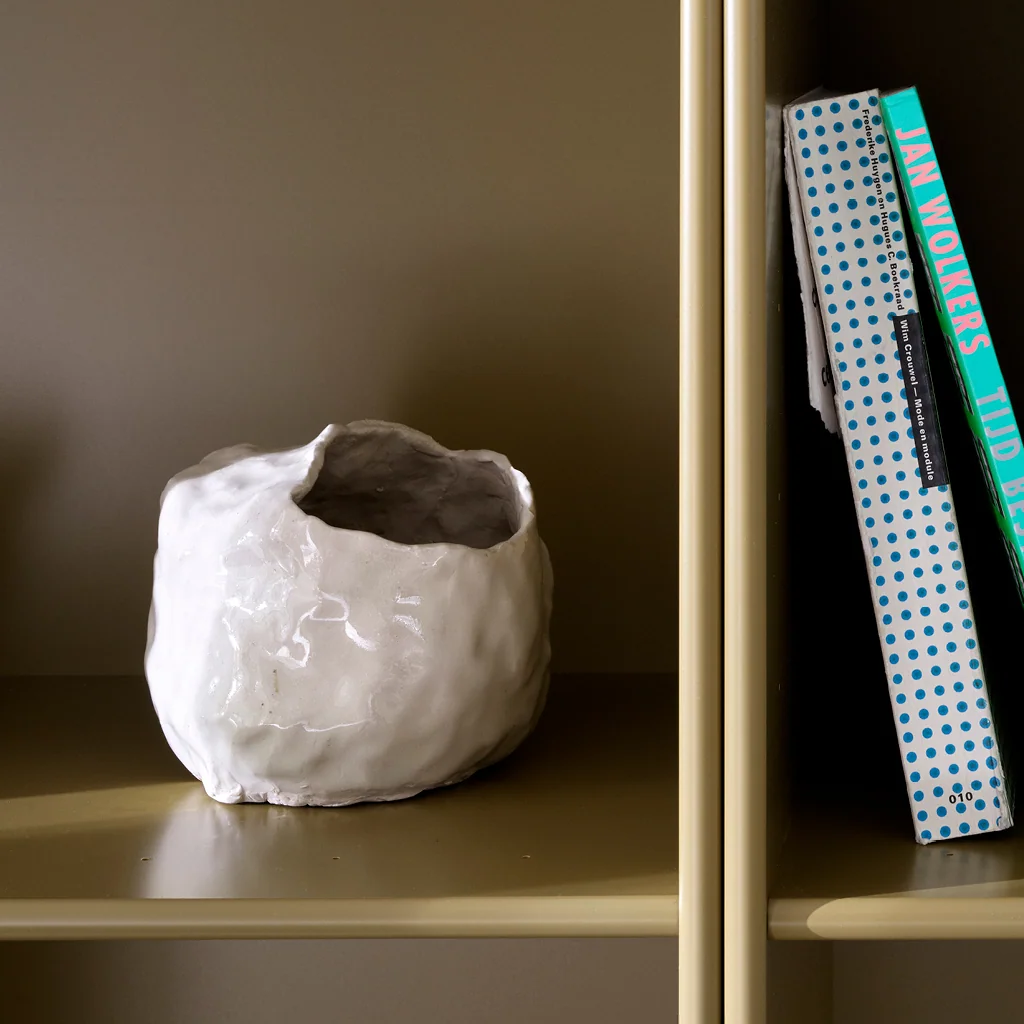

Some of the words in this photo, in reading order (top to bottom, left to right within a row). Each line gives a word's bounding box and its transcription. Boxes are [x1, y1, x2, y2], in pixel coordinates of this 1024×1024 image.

[862, 109, 876, 157] Frederike
[871, 157, 883, 196] Huygen
[878, 198, 885, 210] en
[880, 212, 892, 250] Hugues
[895, 127, 940, 187] JAN
[918, 194, 990, 355] WOLKERS
[887, 251, 895, 261] C.
[890, 263, 905, 311] Boekraad
[900, 319, 909, 342] Wim
[904, 344, 919, 385] Crouwel
[914, 398, 925, 426] Mode
[976, 386, 1021, 461] TIJD
[919, 428, 927, 441] en
[922, 443, 934, 481] module
[948, 792, 973, 805] 010
